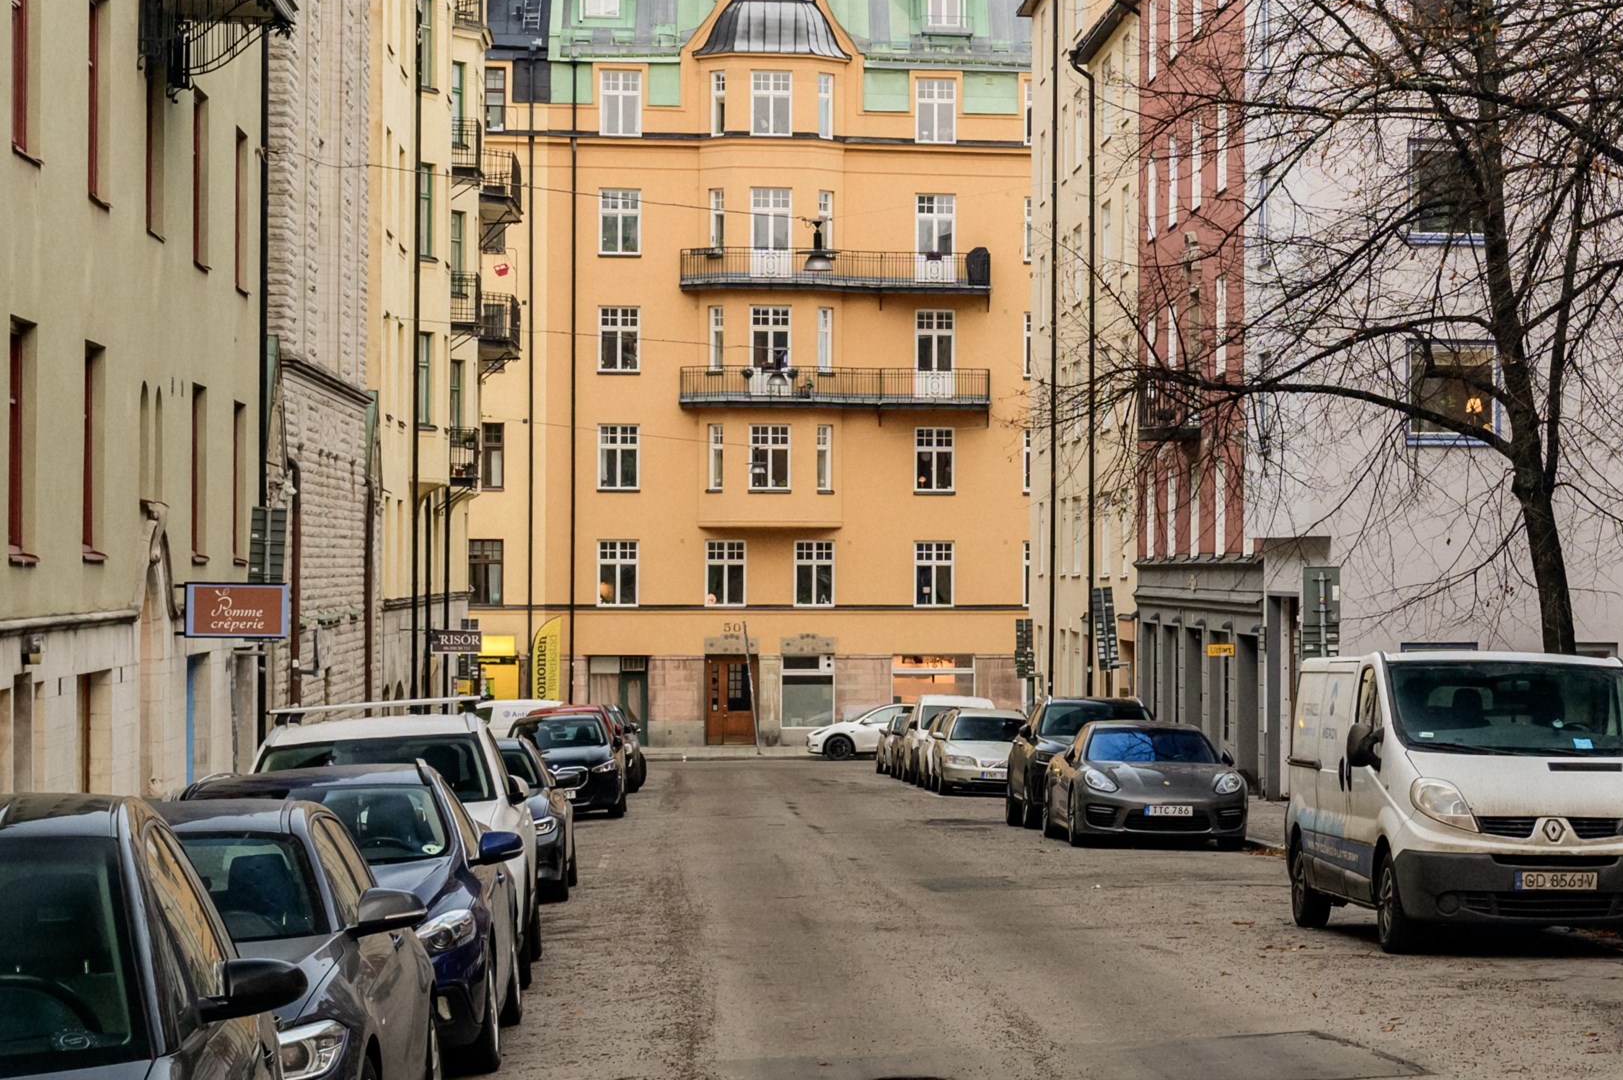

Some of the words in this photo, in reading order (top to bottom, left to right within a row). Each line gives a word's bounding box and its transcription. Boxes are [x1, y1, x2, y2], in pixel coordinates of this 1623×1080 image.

[211, 596, 263, 617] Pomme
[211, 617, 264, 632] crêperie
[724, 622, 741, 632] 50
[438, 633, 480, 645] RISÖR
[548, 634, 557, 691] Bilverkstad
[1153, 806, 1170, 814] TTC
[1172, 806, 1190, 814] 786
[1525, 874, 1546, 888] GD
